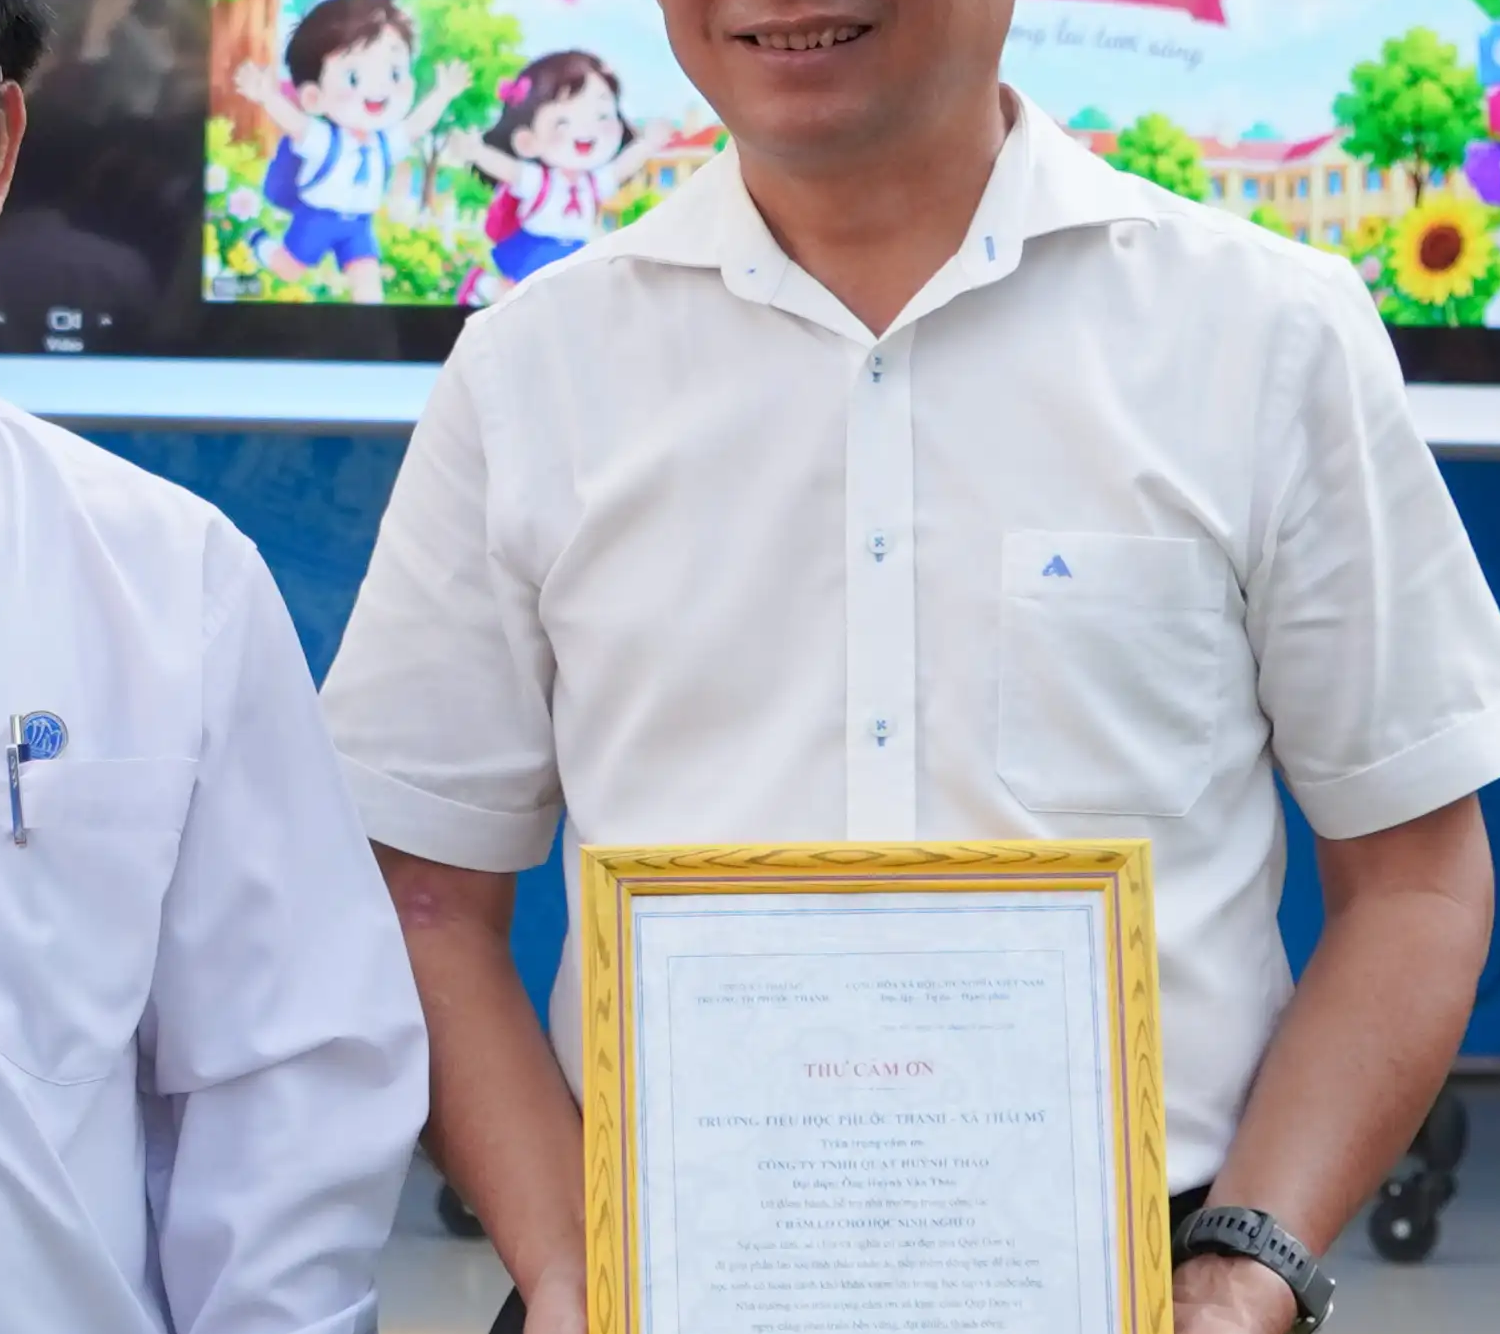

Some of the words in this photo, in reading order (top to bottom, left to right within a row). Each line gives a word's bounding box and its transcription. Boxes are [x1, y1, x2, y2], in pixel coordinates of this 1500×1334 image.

[45, 336, 84, 352] Video
[804, 1058, 849, 1078] THƯ
[853, 1058, 899, 1078] CẢM
[905, 1058, 934, 1077] ƠN
